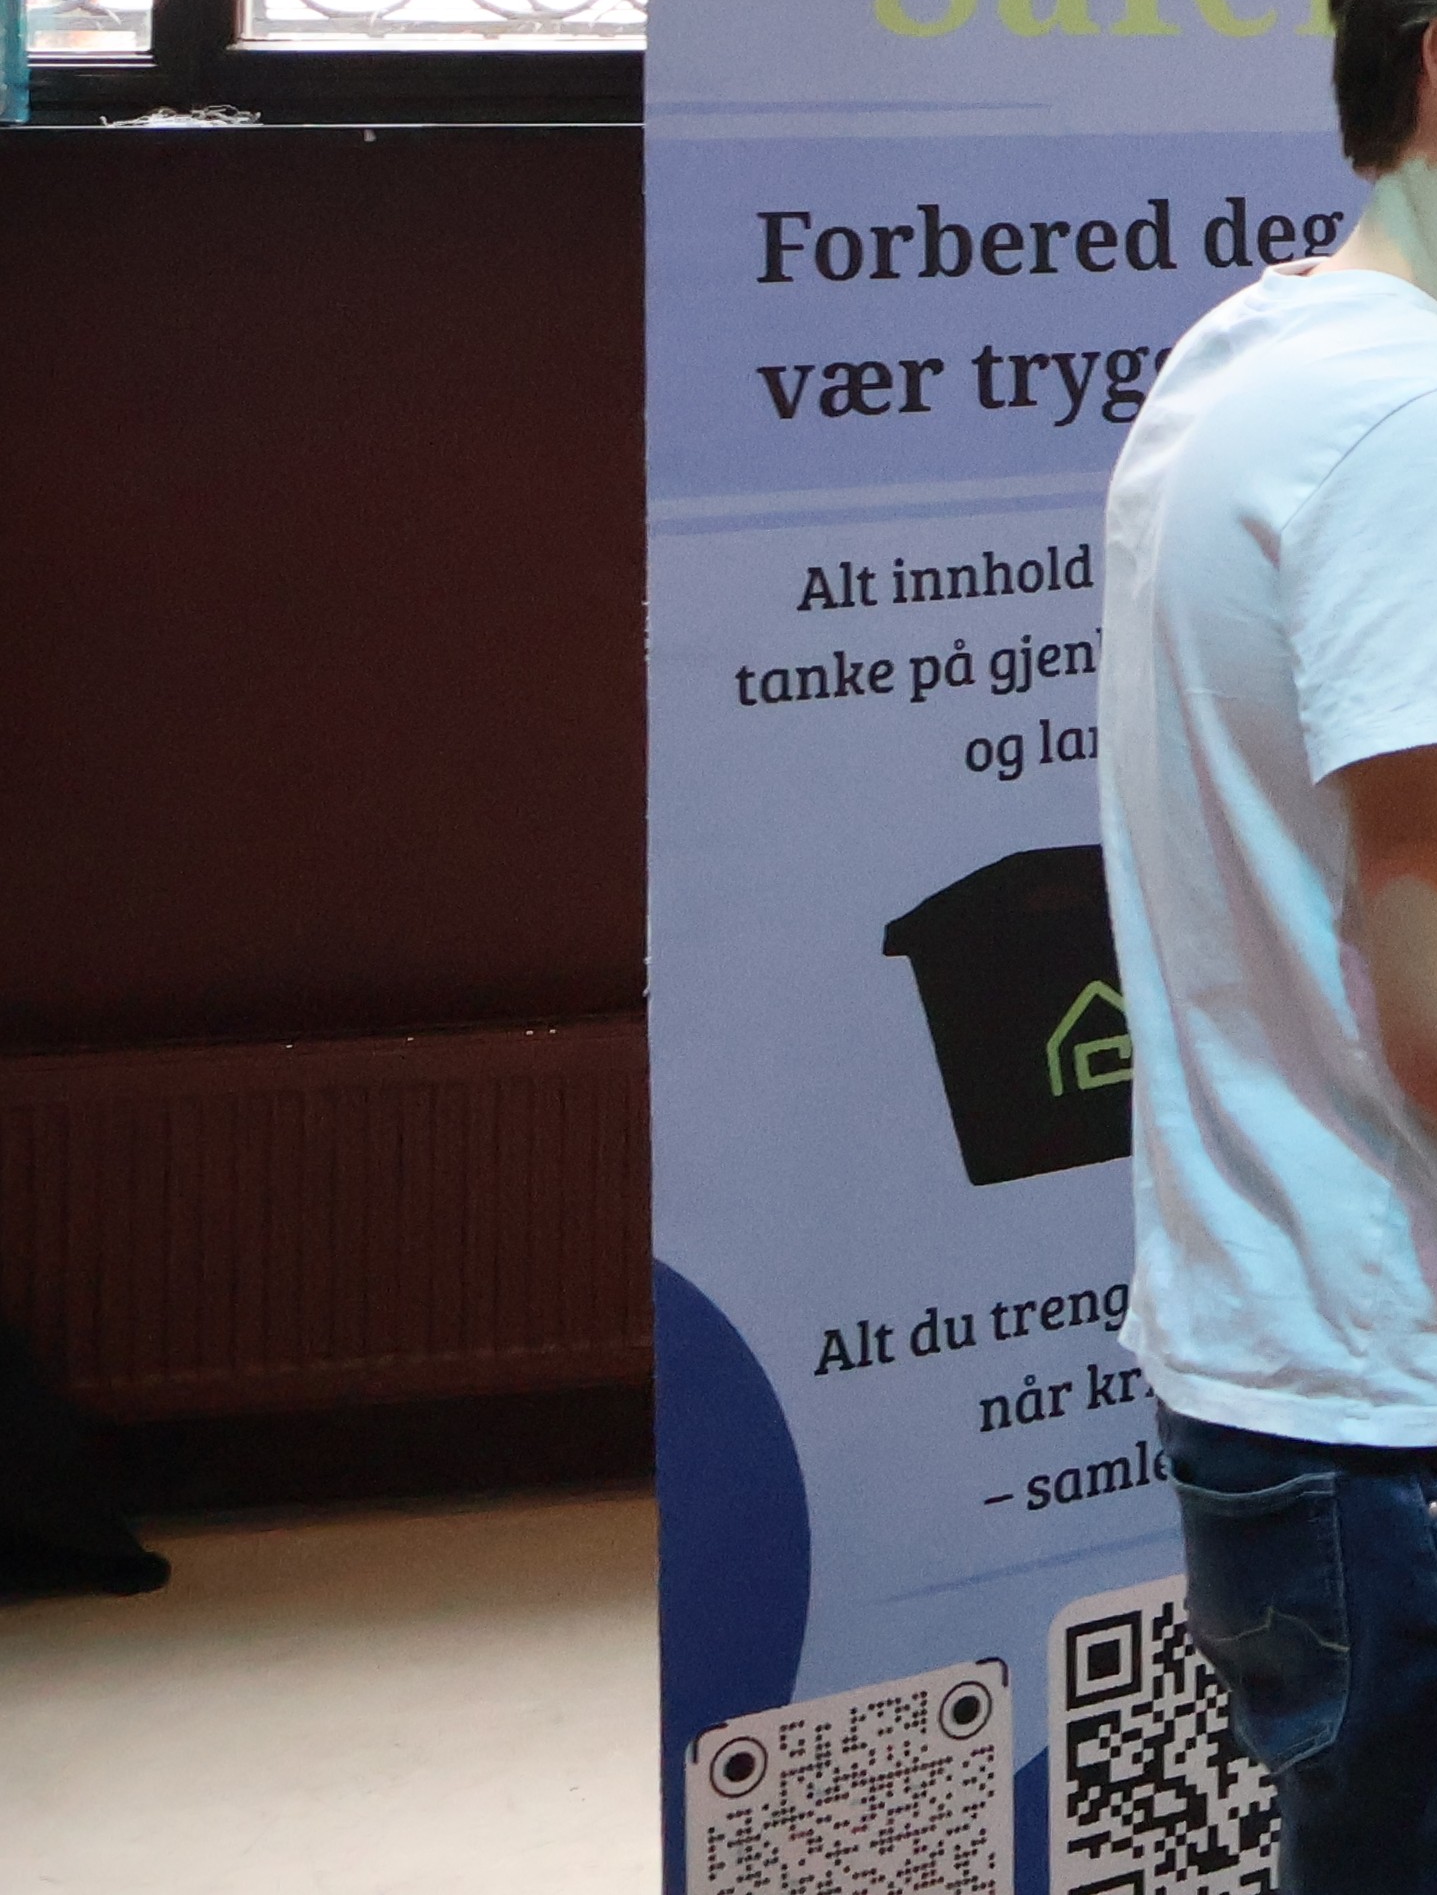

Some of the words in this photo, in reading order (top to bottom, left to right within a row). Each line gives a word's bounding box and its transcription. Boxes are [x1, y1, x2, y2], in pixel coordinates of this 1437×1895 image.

[756, 198, 1178, 283] Forbered
[1204, 196, 1345, 268] deg
[756, 357, 945, 420] vær
[796, 561, 878, 611] Alt
[892, 543, 1095, 604] innhold
[735, 649, 894, 706] tanke
[909, 637, 976, 704] på
[990, 627, 1102, 695] gjen
[965, 733, 1024, 782] og
[813, 1319, 896, 1376] Alt
[909, 1306, 978, 1357] du
[978, 1373, 1073, 1433] når
